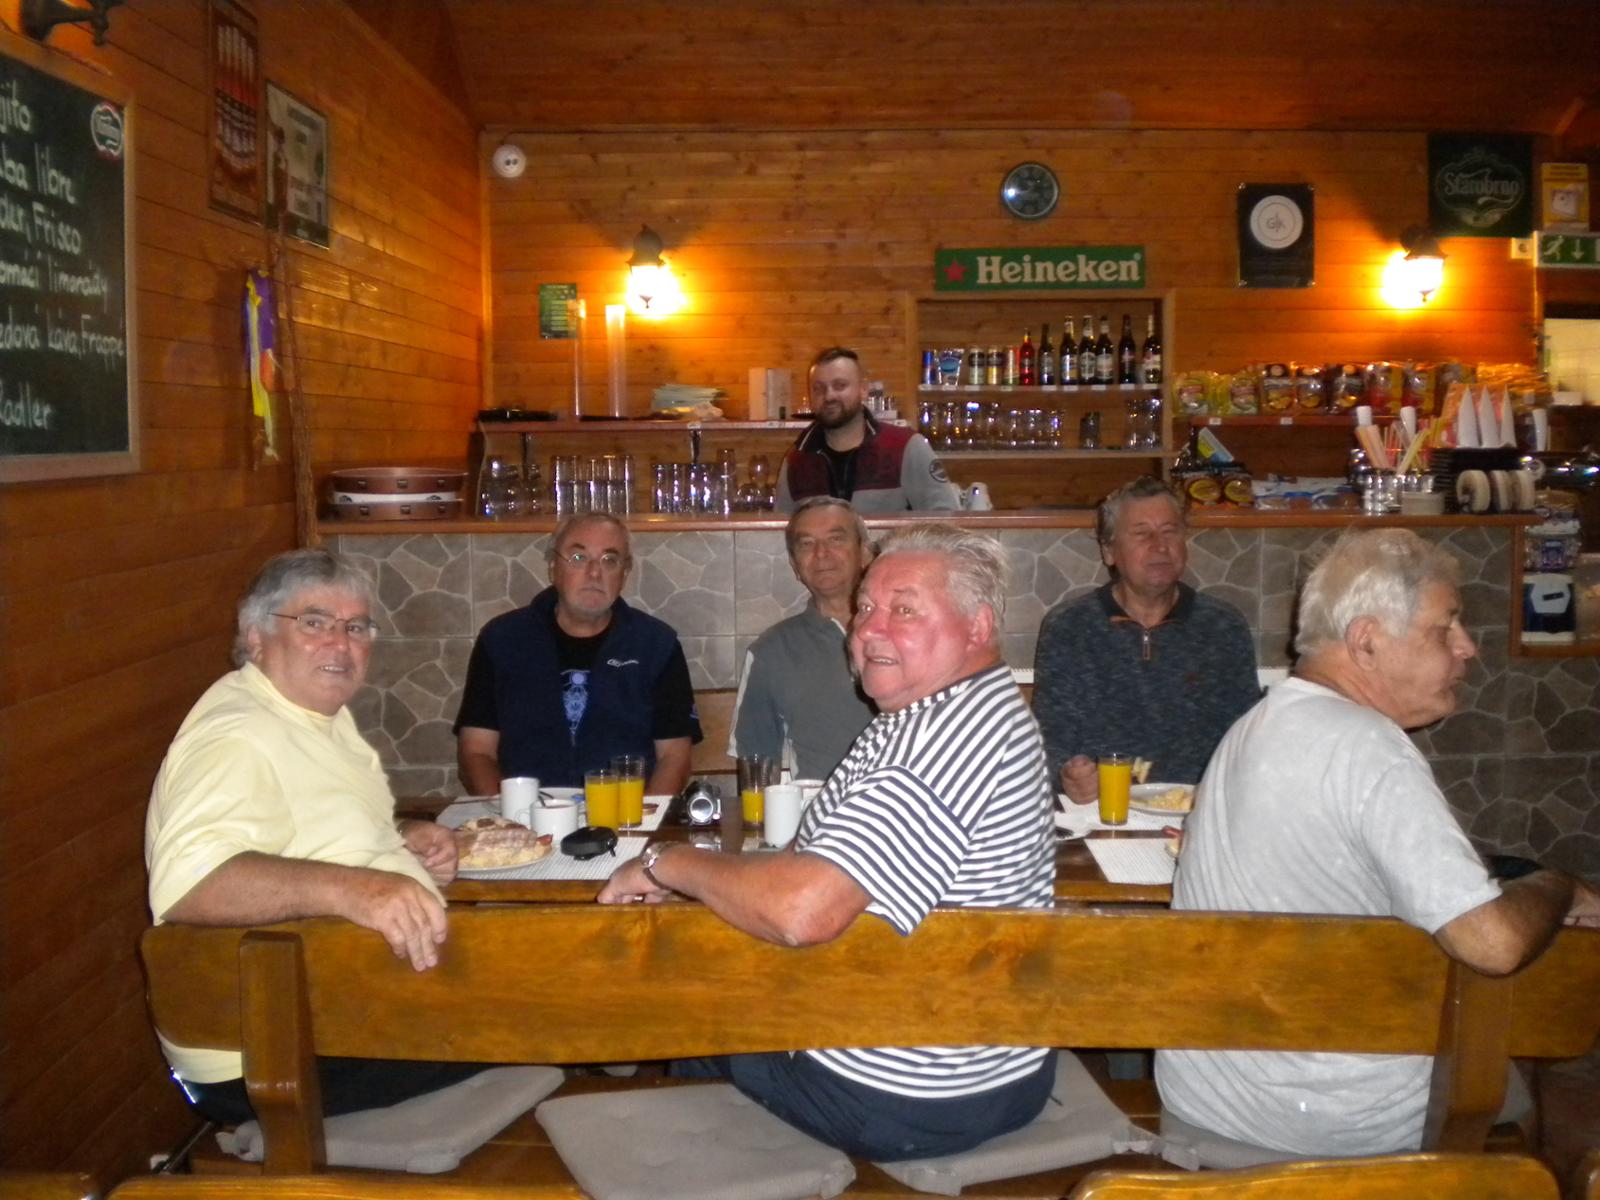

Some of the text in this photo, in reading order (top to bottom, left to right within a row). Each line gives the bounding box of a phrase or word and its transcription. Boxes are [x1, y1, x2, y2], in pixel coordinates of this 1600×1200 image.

[0, 142, 29, 190] ba
[1444, 168, 1519, 197] Starobrno
[32, 201, 81, 256] Frisco
[976, 254, 1141, 285] Heineken
